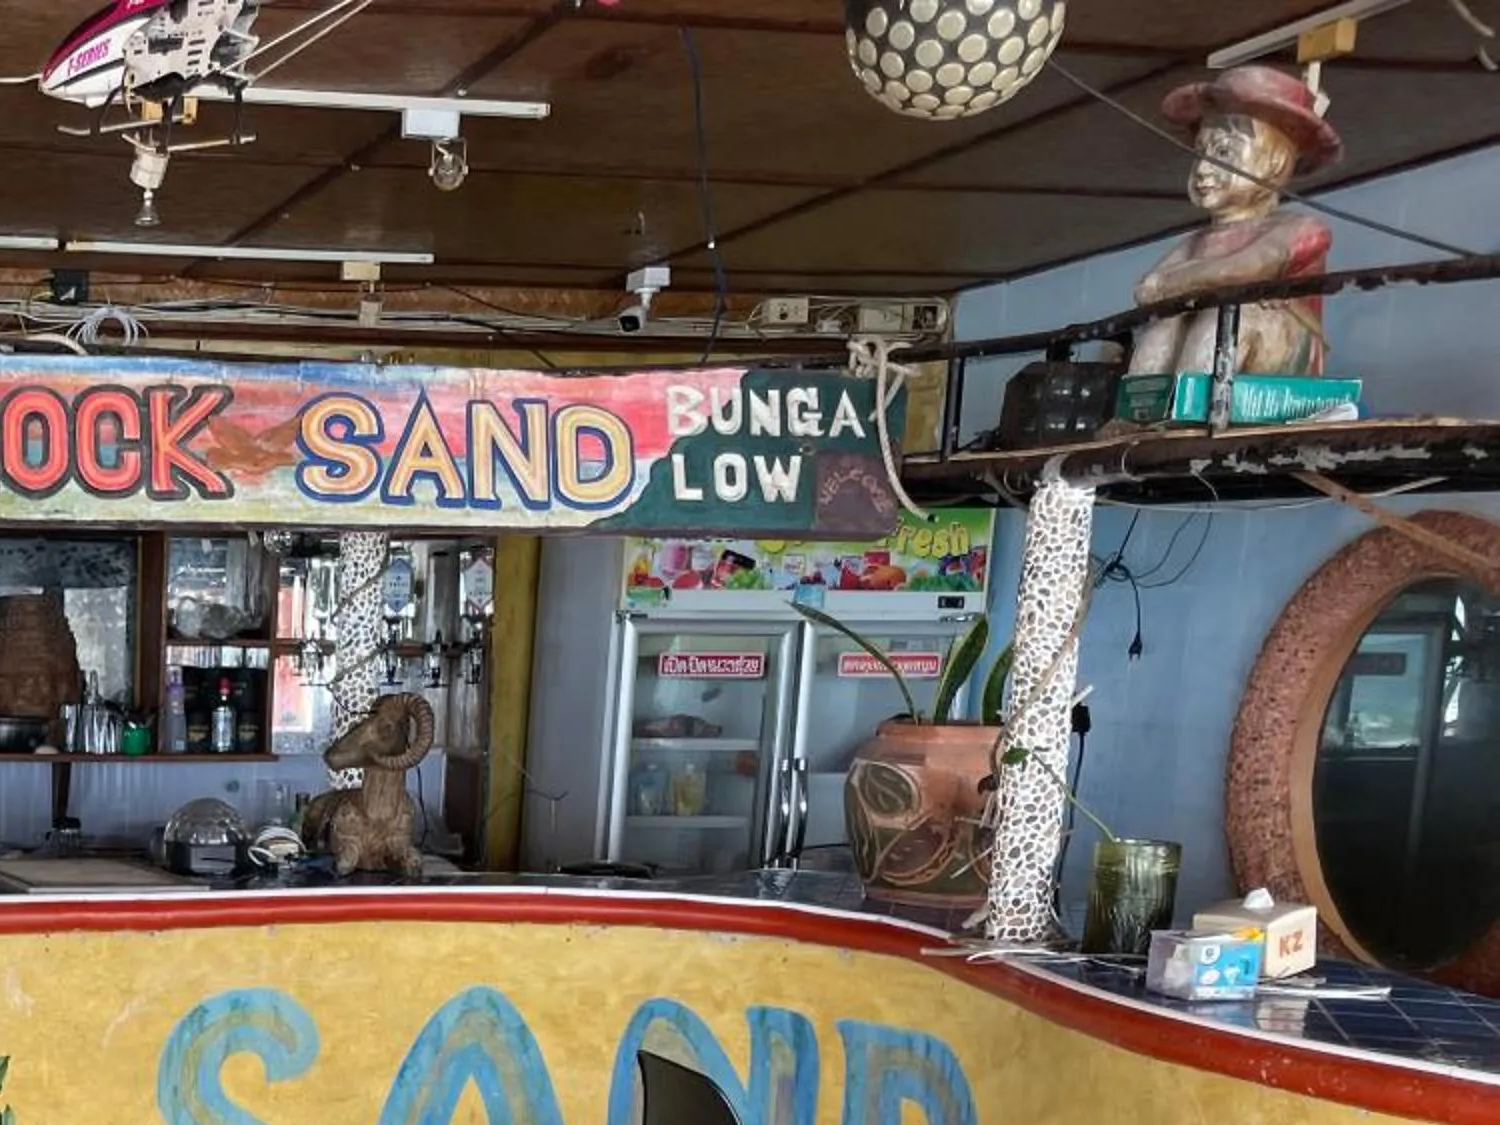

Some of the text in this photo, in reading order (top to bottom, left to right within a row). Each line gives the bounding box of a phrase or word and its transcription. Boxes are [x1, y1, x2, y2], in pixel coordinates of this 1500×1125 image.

[666, 384, 867, 438] BUNGA
[296, 384, 635, 511] SAND
[671, 452, 803, 503] LOW
[819, 467, 894, 514] WELCOME
